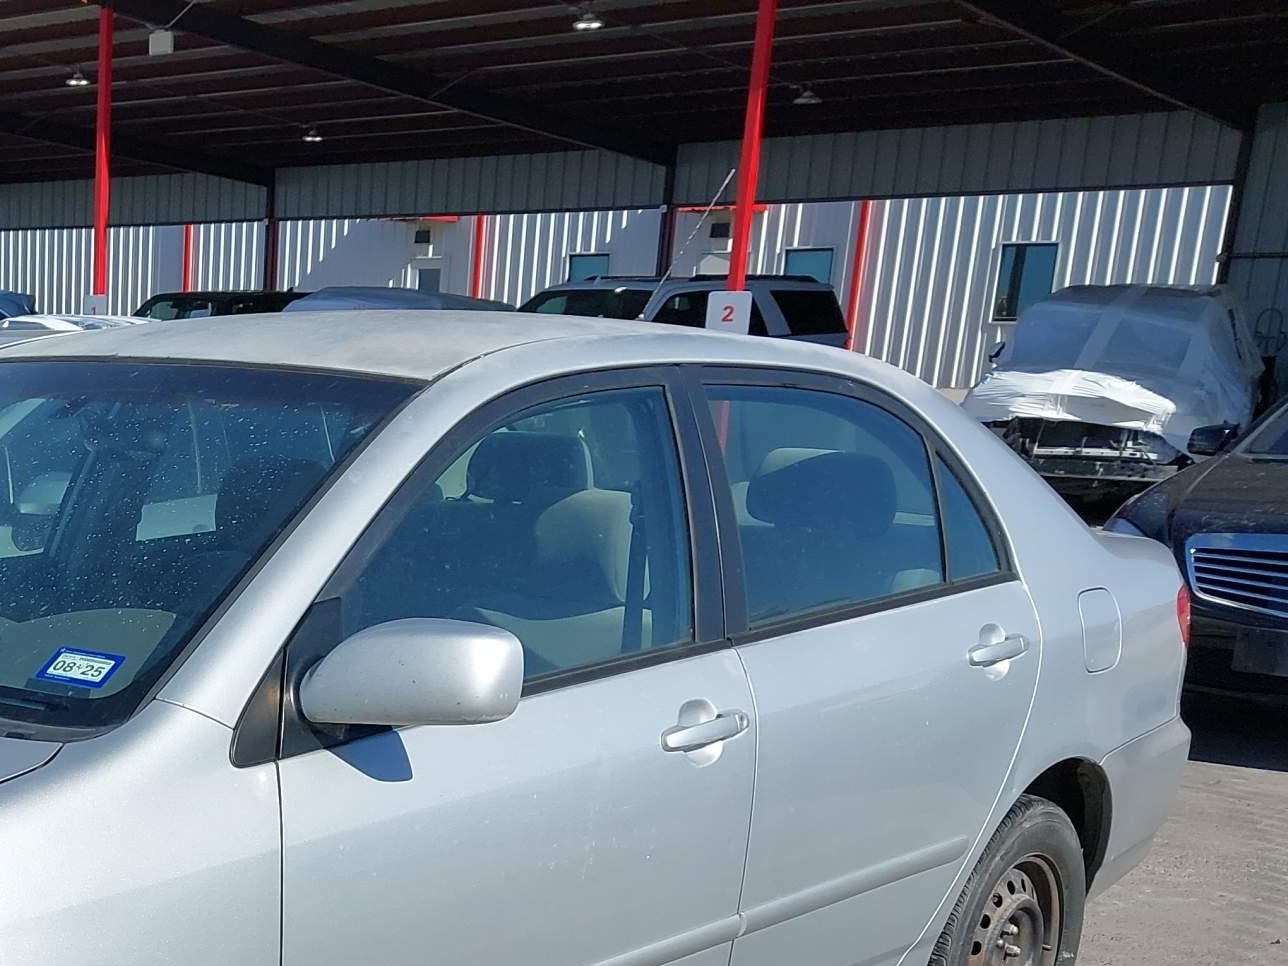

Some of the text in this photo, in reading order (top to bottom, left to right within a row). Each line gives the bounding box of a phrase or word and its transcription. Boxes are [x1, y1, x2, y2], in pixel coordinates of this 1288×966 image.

[721, 305, 734, 322] 2
[52, 660, 76, 673] 08
[80, 664, 106, 678] 25
